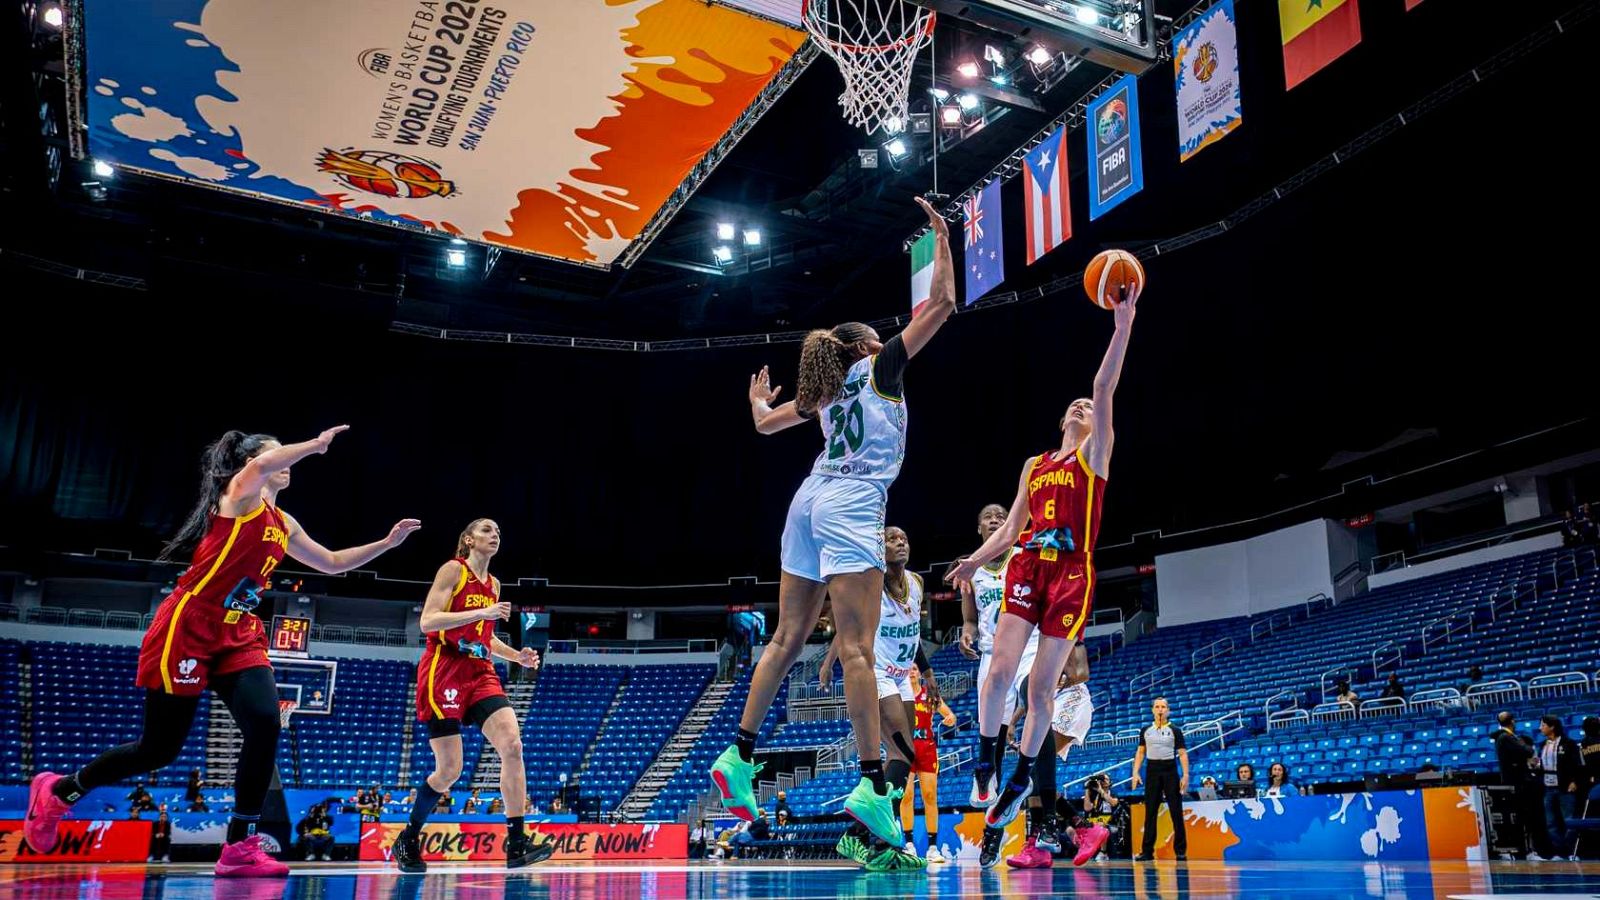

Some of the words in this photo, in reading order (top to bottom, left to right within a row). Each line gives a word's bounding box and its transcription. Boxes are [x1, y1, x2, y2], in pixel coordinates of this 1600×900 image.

[436, 0, 480, 45] 202
[506, 21, 536, 54] RICO
[370, 52, 392, 75] FIBA
[420, 45, 456, 85] CUP
[426, 94, 469, 148] QUALIFYING
[450, 7, 507, 94] TOURNAMENTS
[484, 54, 520, 101] PUERTO
[371, 81, 408, 140] WOMEN'S
[1205, 92, 1218, 103] CUP
[393, 88, 439, 146] WORLD
[468, 102, 497, 131] JUAN
[459, 130, 482, 151] SAN
[1102, 147, 1126, 175] FIBA
[829, 399, 864, 460] 20
[1045, 499, 1056, 520] 6
[260, 556, 278, 577] 17
[283, 619, 307, 632] 3:21
[475, 619, 485, 637] 4
[896, 643, 916, 662] 24
[419, 831, 497, 855] ICKETS
[595, 831, 650, 854] NOW!
